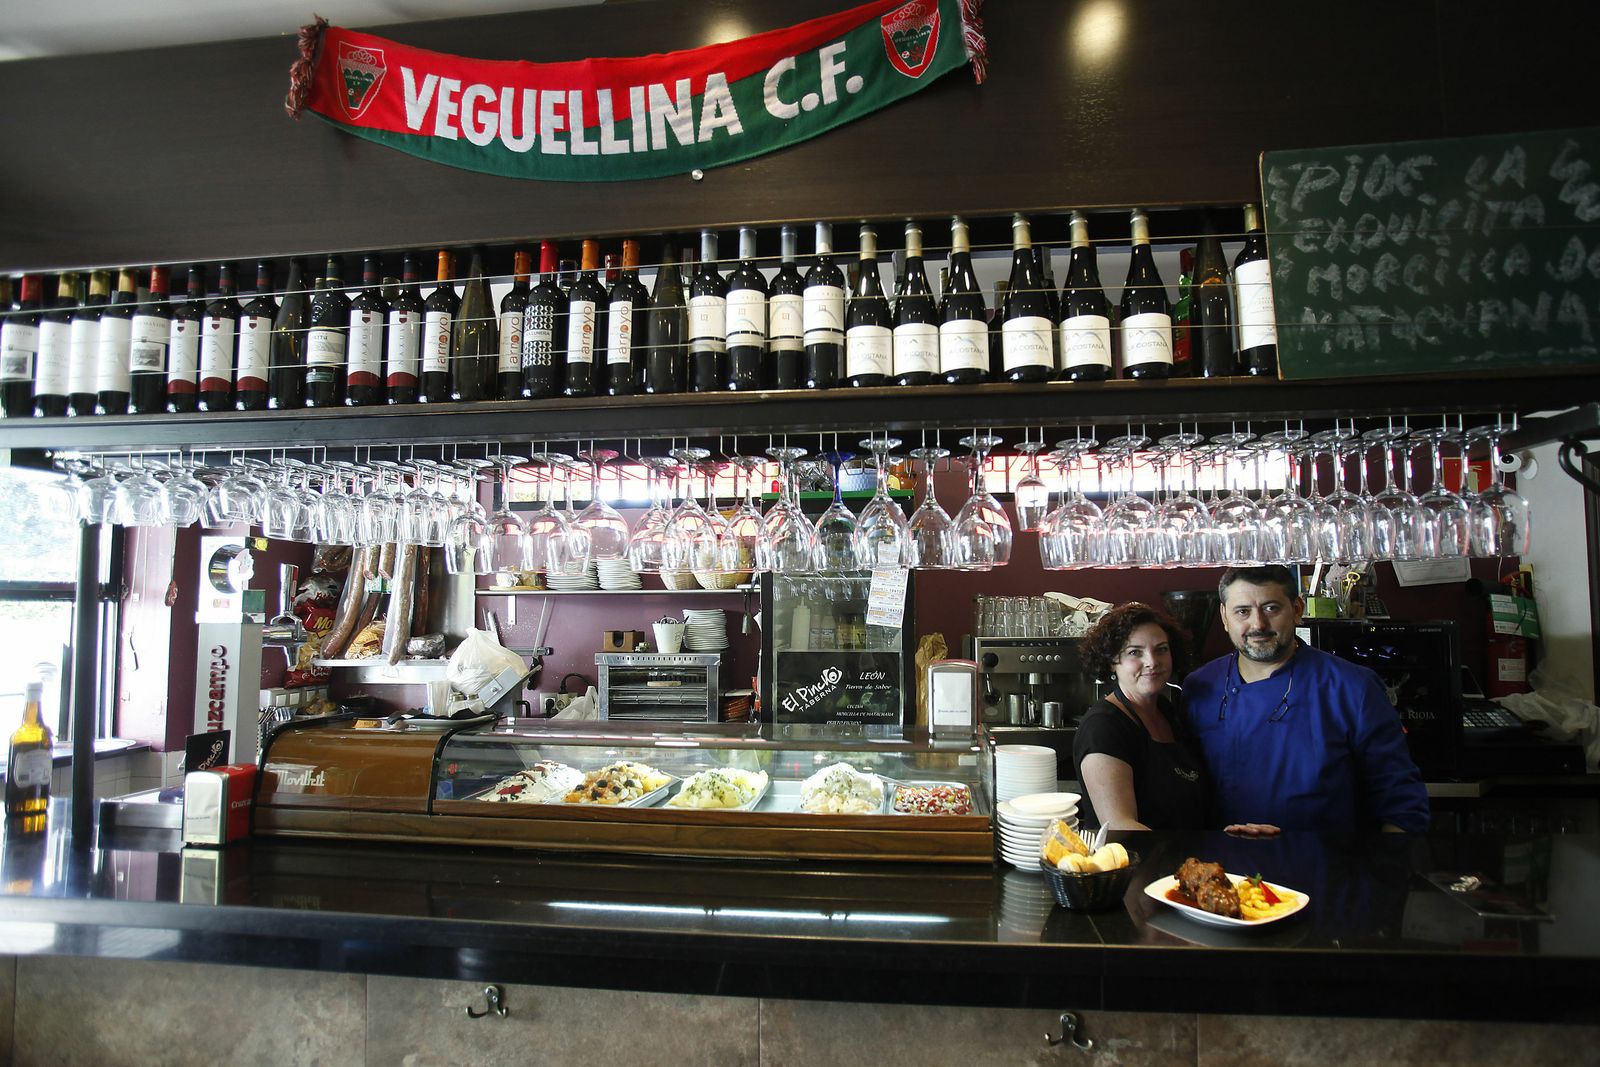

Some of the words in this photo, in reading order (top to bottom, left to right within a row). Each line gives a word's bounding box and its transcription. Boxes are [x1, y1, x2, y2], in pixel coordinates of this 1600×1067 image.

[401, 66, 746, 155] VEGUELLINA
[764, 41, 864, 119] C.F.
[437, 317, 449, 365] arroyo
[510, 317, 523, 364] arroyo
[581, 305, 596, 355] arroyo
[618, 305, 632, 355] arroyo
[207, 644, 228, 732] uzcampo
[781, 693, 800, 713] El
[796, 666, 843, 703] Pincho
[799, 685, 838, 713] TABERNA
[860, 670, 886, 681] LEÓN
[1407, 710, 1435, 720] RIOJA
[278, 770, 327, 787] Movilfrit
